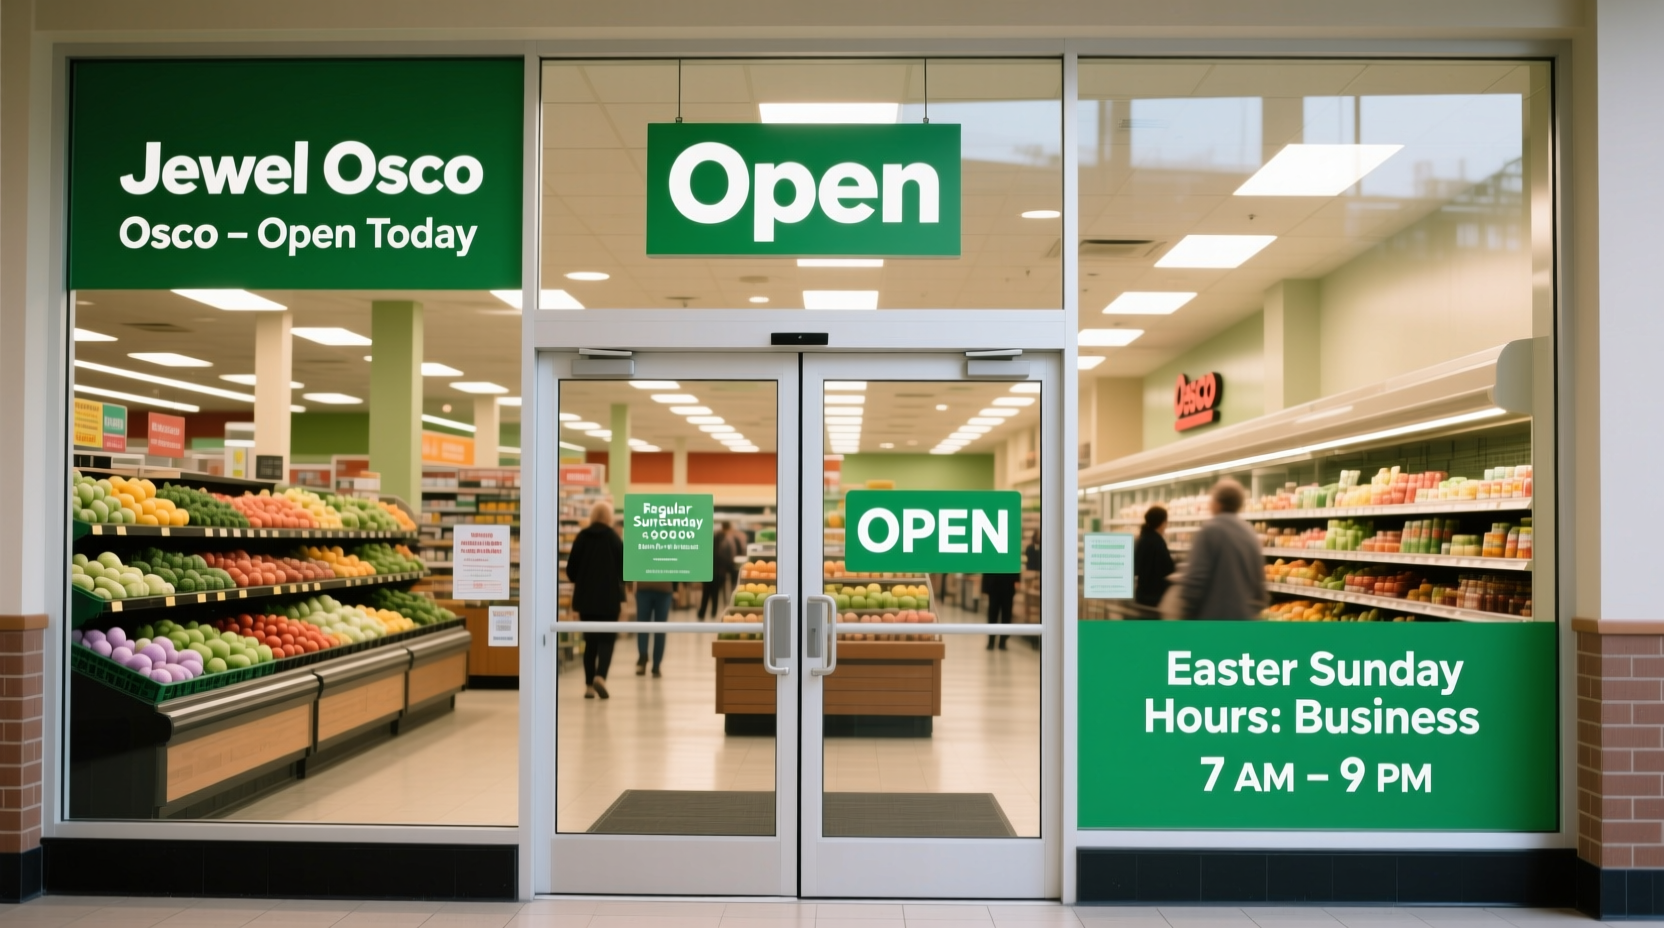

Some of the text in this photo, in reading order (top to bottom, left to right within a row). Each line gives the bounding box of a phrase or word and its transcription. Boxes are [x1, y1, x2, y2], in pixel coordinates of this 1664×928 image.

[119, 140, 484, 195] Jewel Osco
[668, 141, 941, 243] Open
[119, 215, 219, 250] Osco
[257, 216, 356, 257] Open
[366, 216, 478, 257] Today
[857, 507, 1009, 554] OPEN
[1167, 650, 1464, 696] Easter Sunday
[1145, 696, 1480, 735] Hours: Business
[1200, 756, 1225, 792] 7
[1233, 762, 1295, 792] AM
[1340, 756, 1366, 793] 9
[1377, 762, 1432, 793] PM
